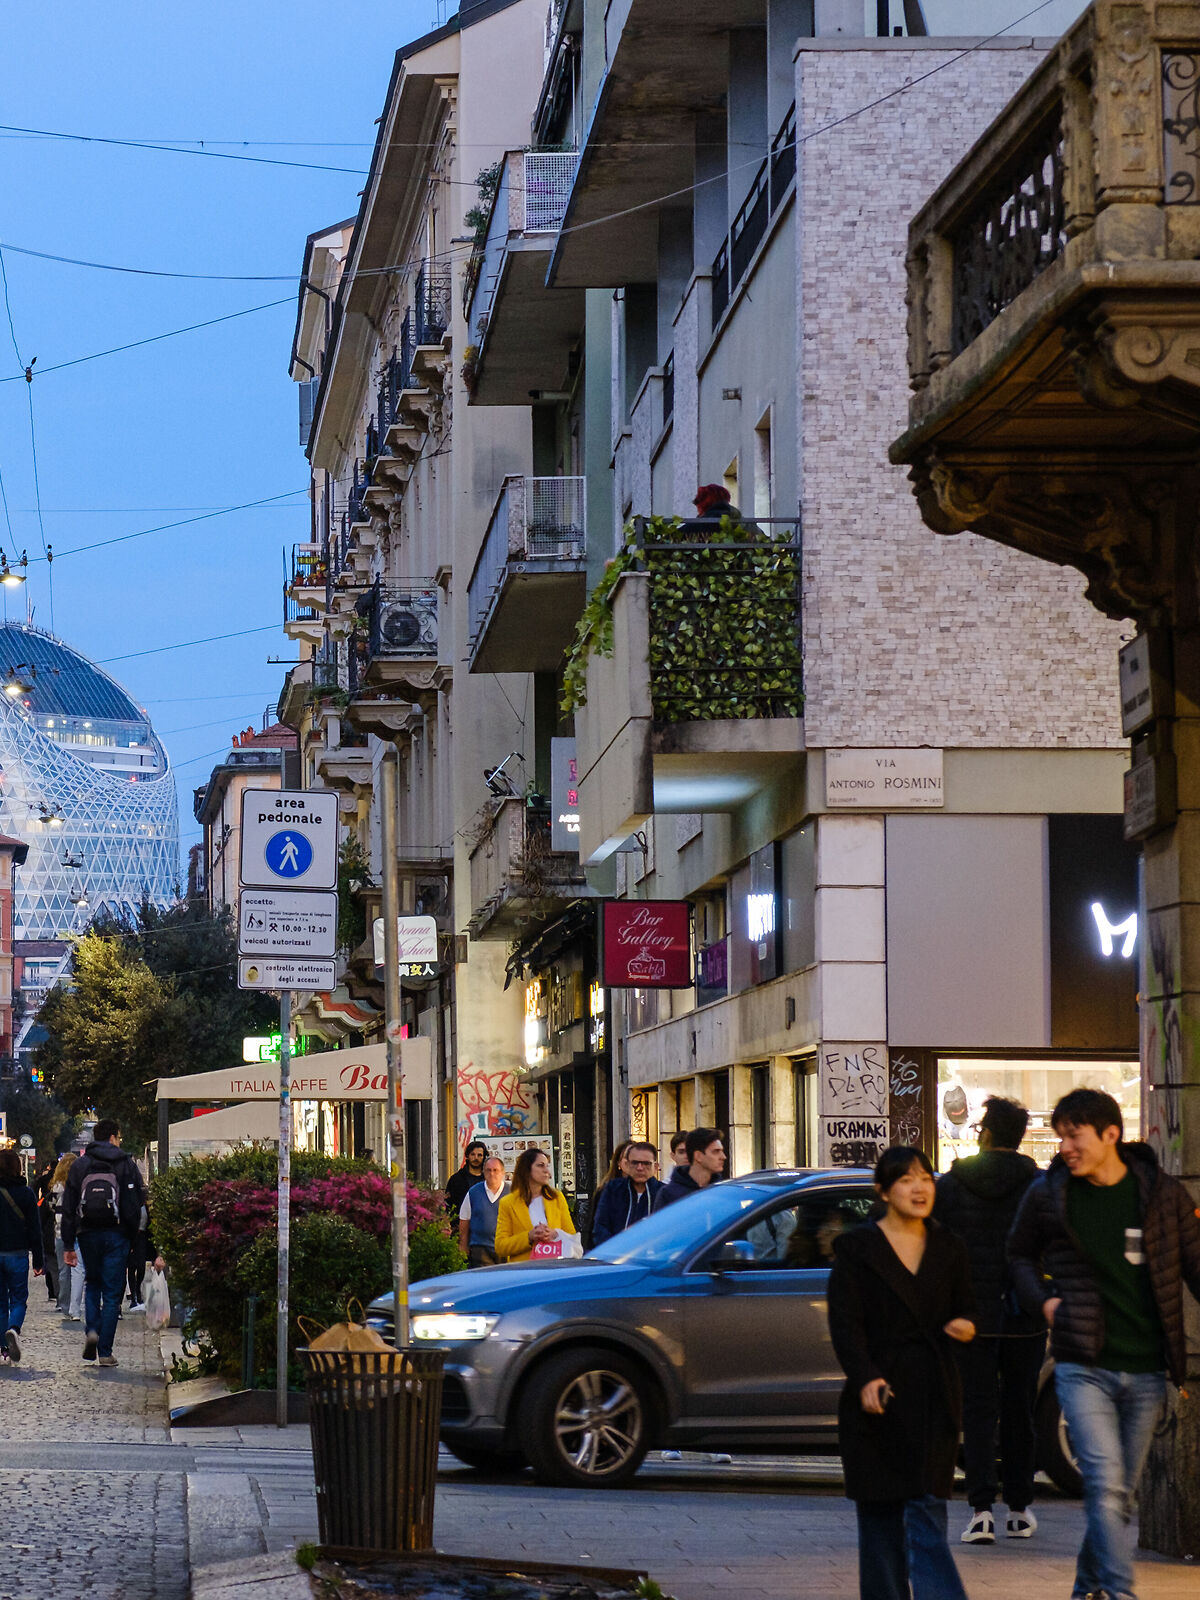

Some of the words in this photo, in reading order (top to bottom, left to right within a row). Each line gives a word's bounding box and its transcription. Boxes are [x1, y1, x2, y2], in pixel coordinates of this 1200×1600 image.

[876, 759, 897, 768] VIA
[828, 780, 875, 789] ANTONIO
[884, 777, 942, 789] ROSMINI
[275, 799, 305, 809] area
[258, 812, 323, 824] pedonale
[567, 824, 580, 832] LA
[626, 907, 663, 926] Bar
[244, 937, 269, 945] veicoli
[272, 939, 312, 947] autorizzati
[617, 926, 675, 950] Gallery
[265, 964, 295, 972] controllo
[298, 965, 333, 973] elettronico
[278, 975, 294, 984] degli
[231, 1079, 276, 1092] ITALIA
[289, 1078, 328, 1092] AFFE
[340, 1063, 406, 1090] Ba
